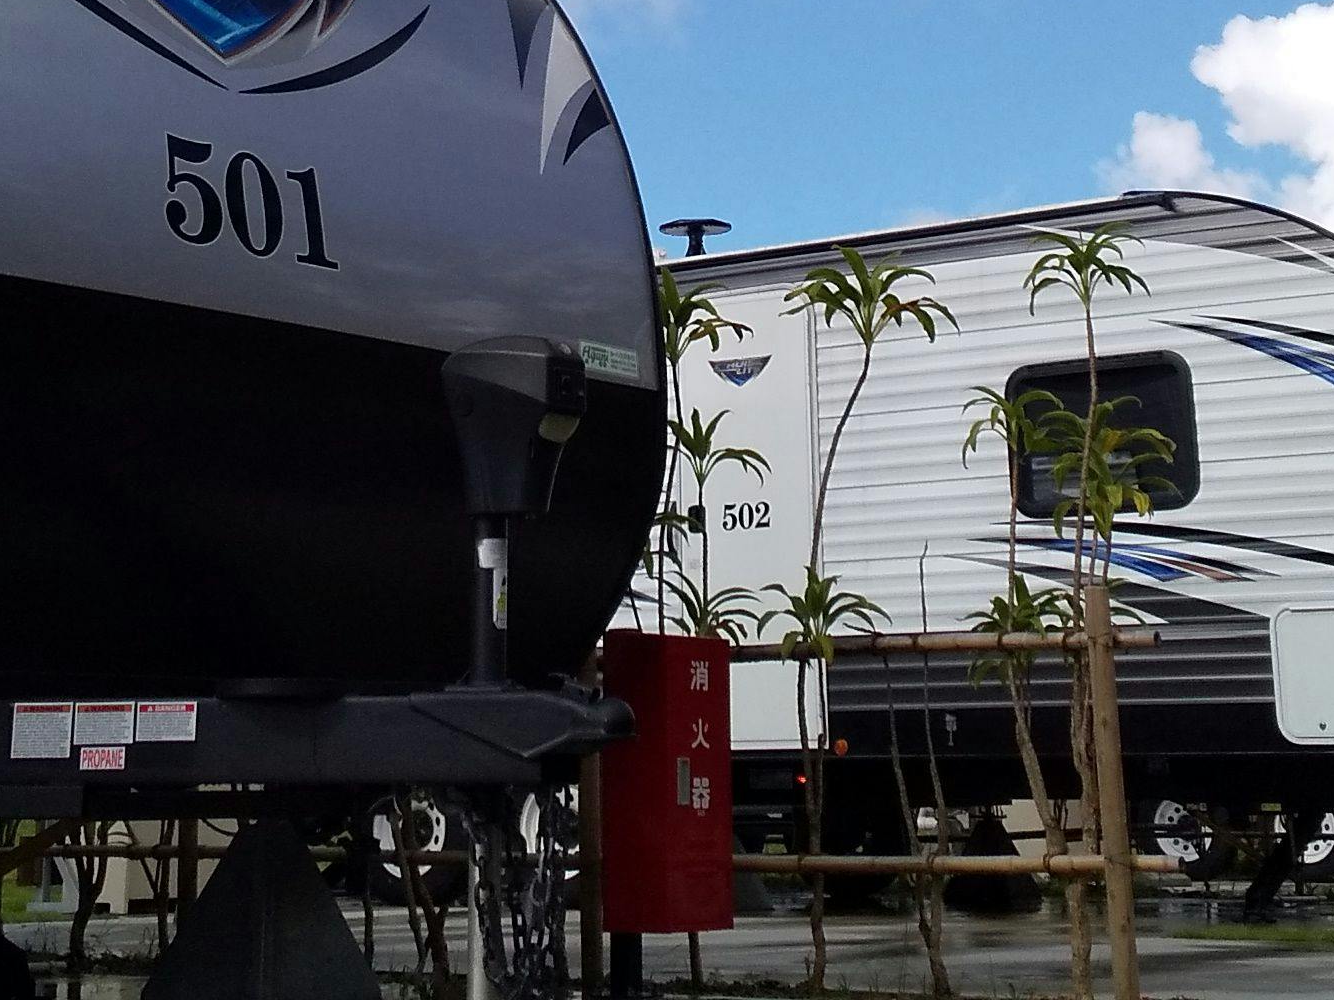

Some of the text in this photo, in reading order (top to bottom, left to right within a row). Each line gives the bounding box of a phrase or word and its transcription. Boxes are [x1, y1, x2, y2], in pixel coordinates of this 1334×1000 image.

[165, 131, 340, 271] 501
[722, 501, 772, 531] 502
[81, 749, 124, 768] PROPANE
[689, 659, 711, 810] 消火器
